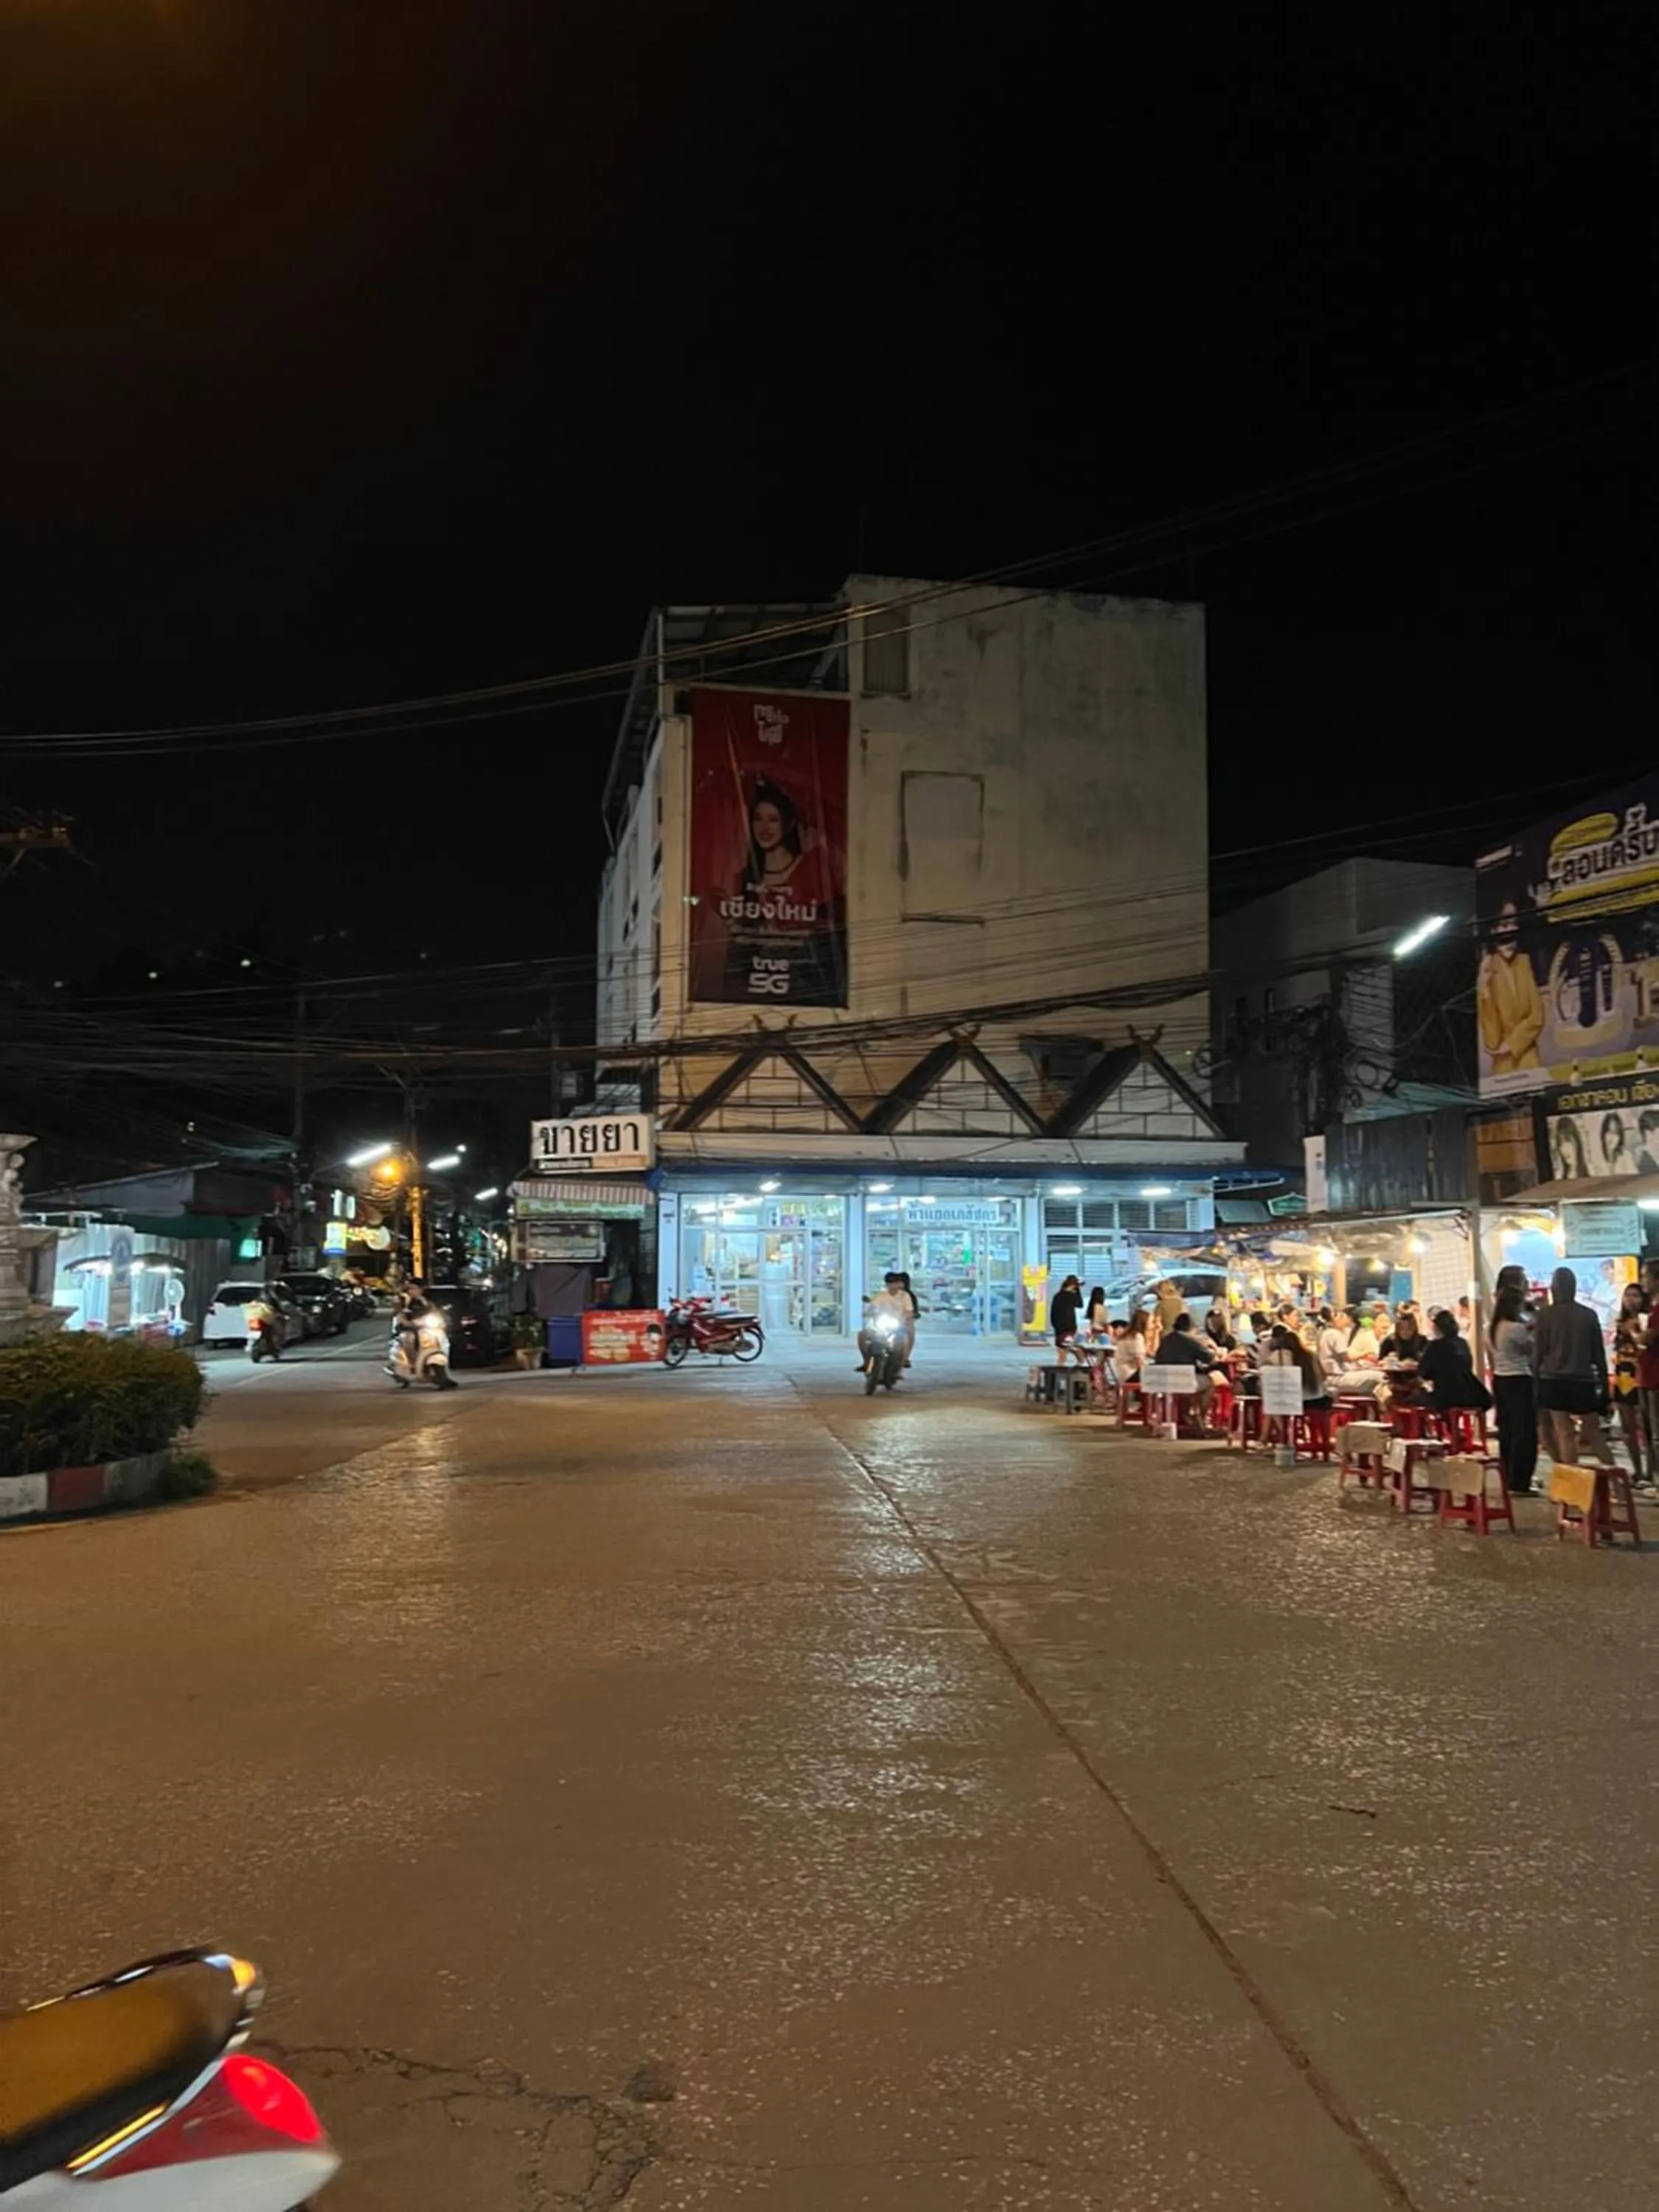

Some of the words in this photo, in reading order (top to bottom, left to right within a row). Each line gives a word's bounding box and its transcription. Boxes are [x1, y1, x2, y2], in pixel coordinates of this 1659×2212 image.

[720, 895, 817, 921] เชียงใหม่
[753, 956, 790, 971] true
[748, 973, 790, 994] 5G
[540, 1121, 639, 1155] ขายยา
